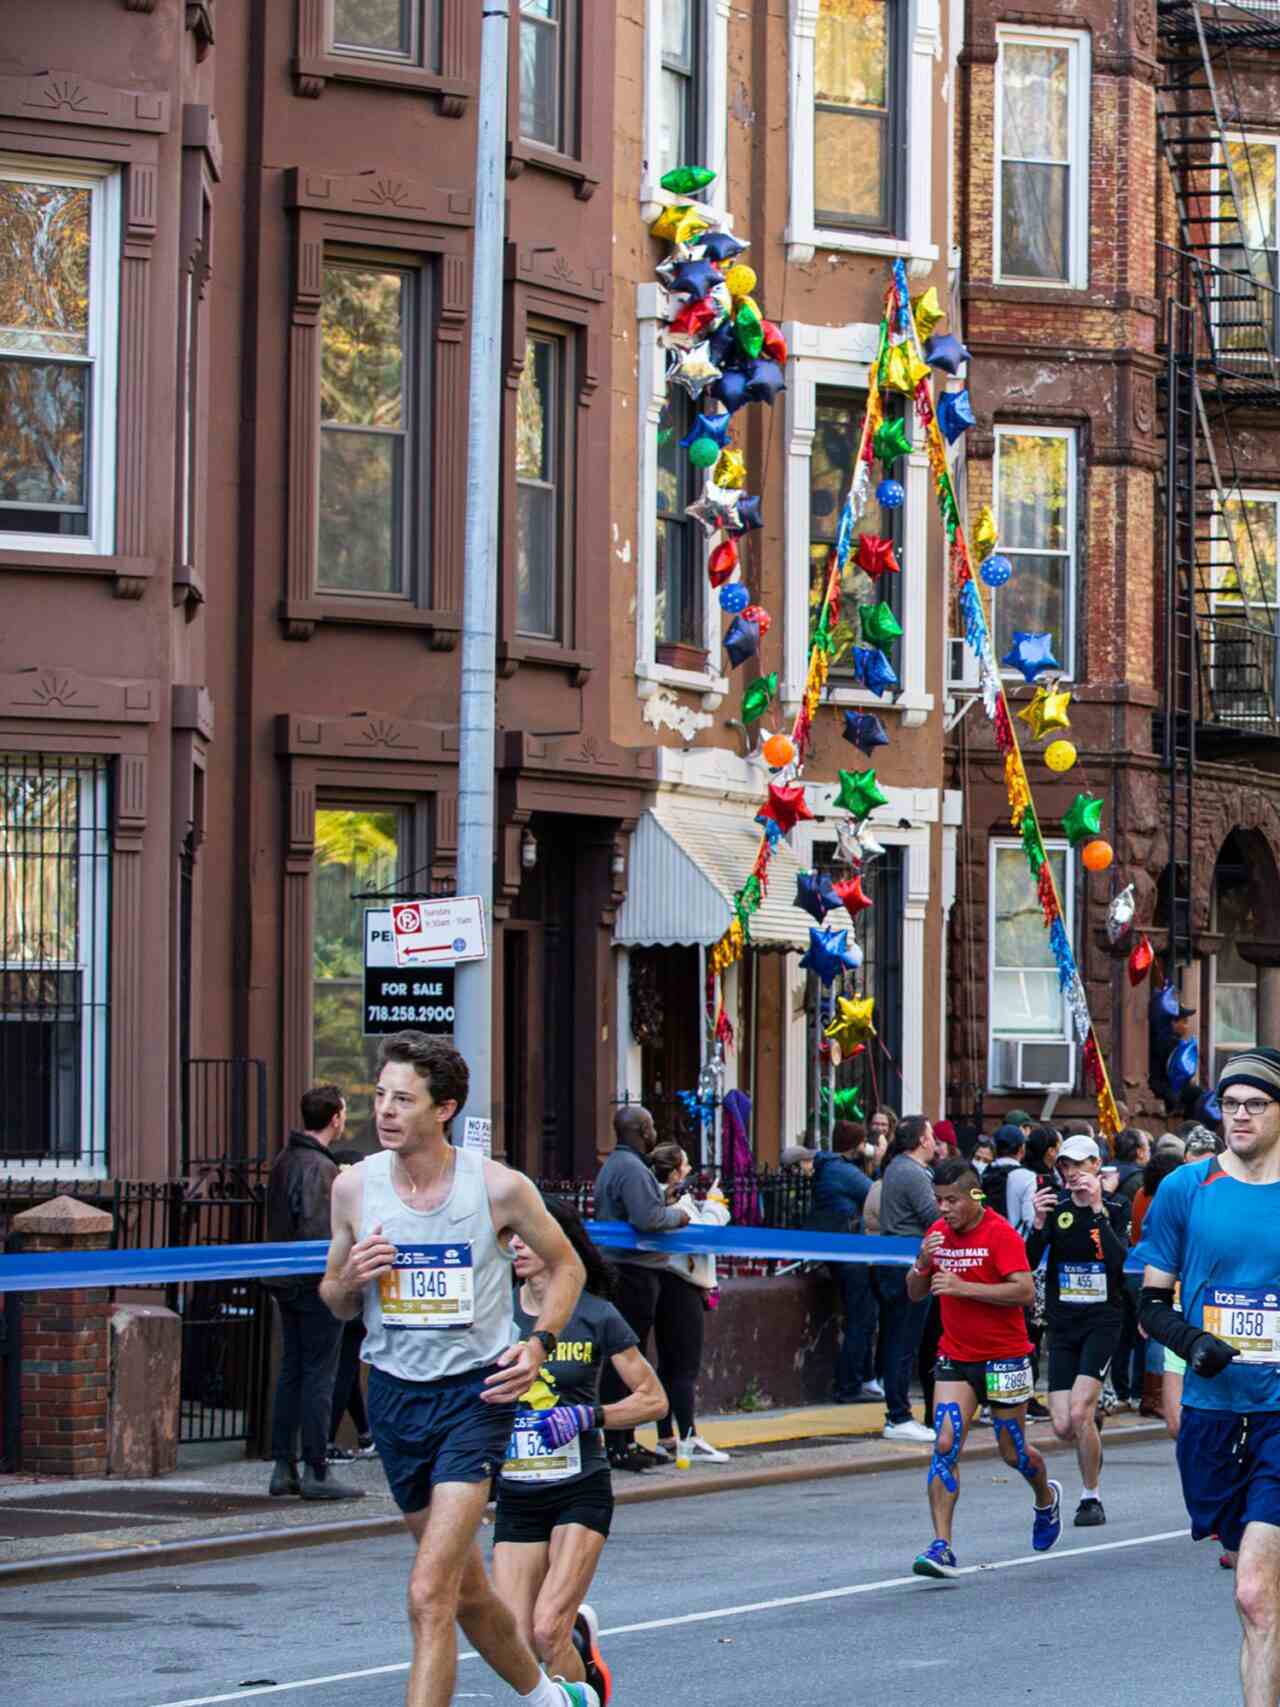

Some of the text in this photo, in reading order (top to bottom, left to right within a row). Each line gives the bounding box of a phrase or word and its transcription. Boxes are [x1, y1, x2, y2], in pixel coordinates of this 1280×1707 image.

[381, 982, 443, 996] FOR SALE
[368, 1005, 455, 1022] 718.258.2900
[411, 1271, 447, 1298] 1346
[1214, 1290, 1234, 1305] tcs
[1231, 1311, 1264, 1336] 1358
